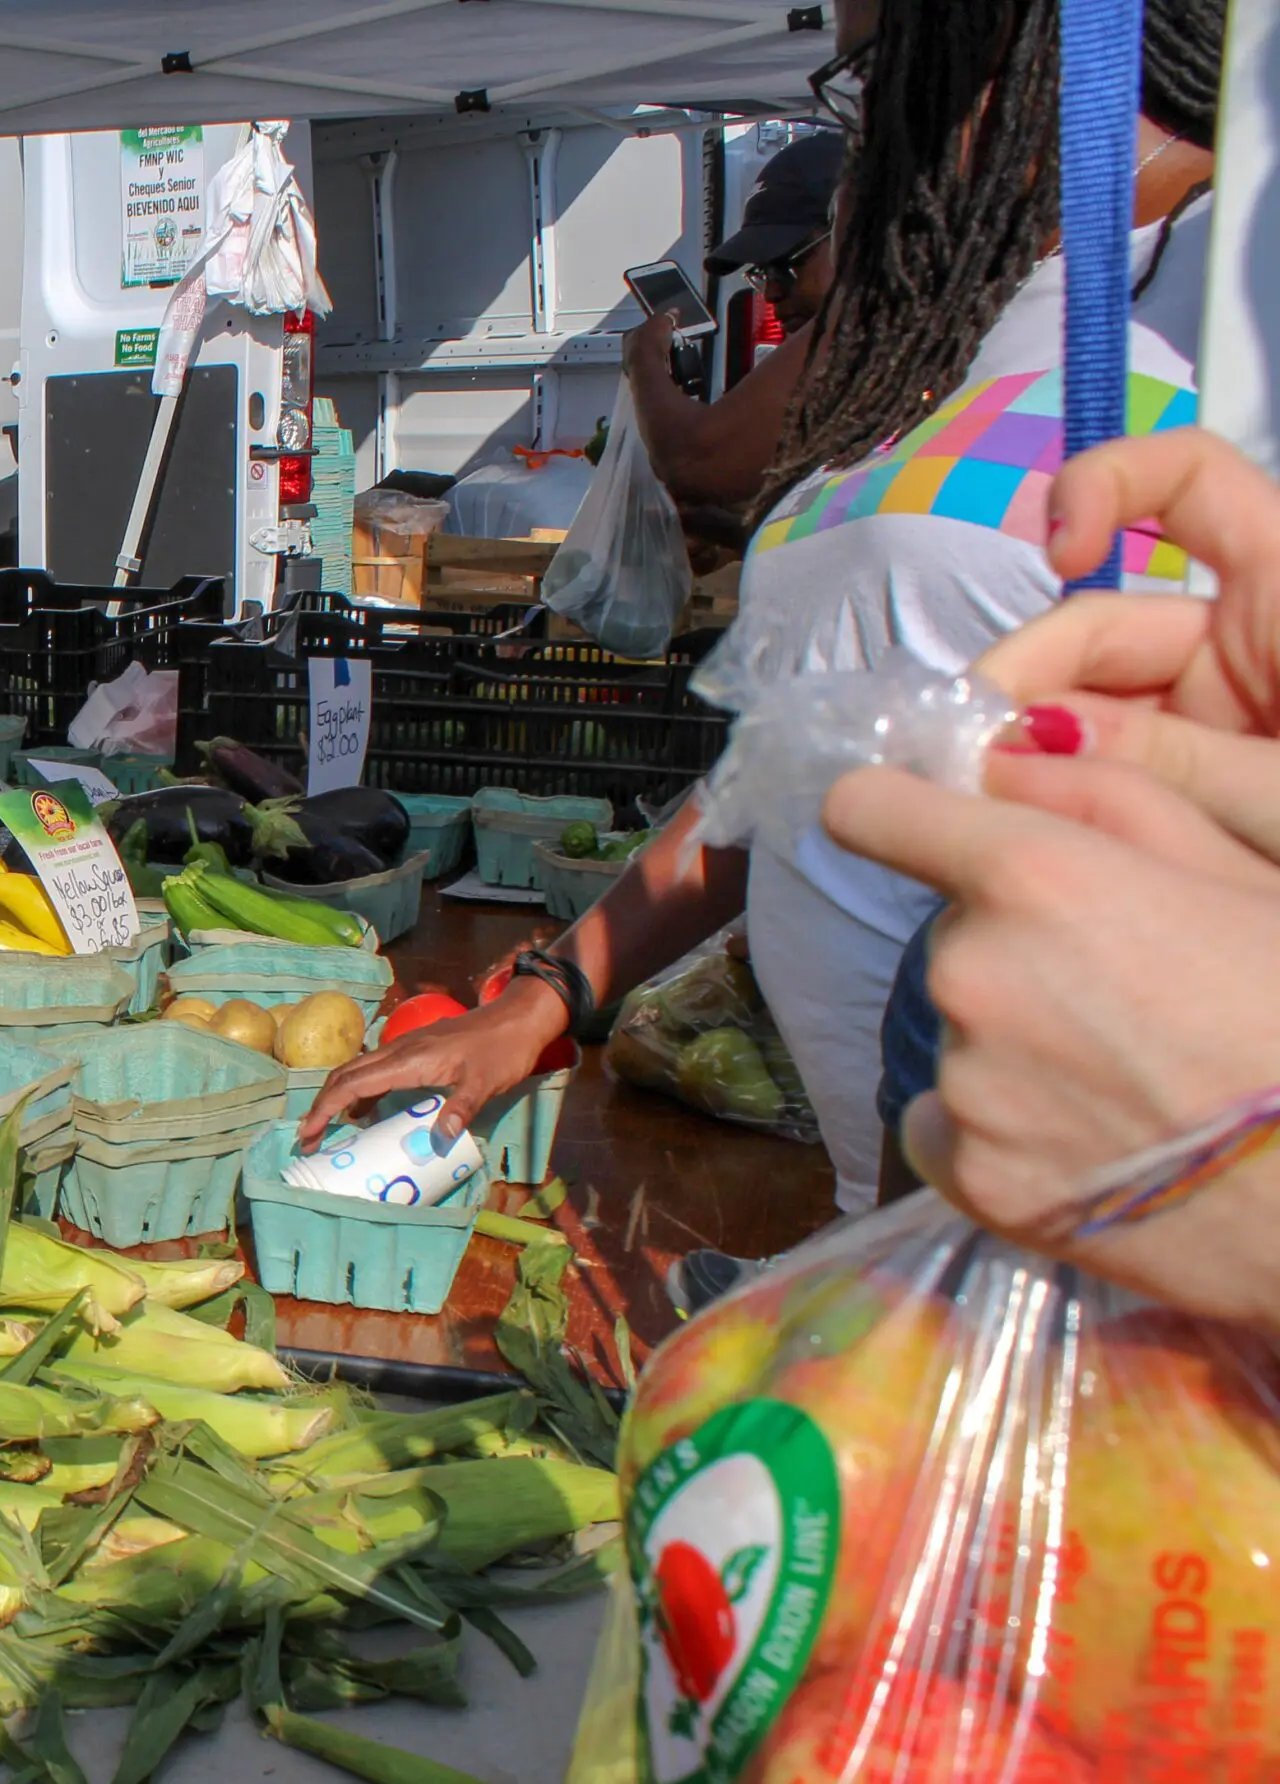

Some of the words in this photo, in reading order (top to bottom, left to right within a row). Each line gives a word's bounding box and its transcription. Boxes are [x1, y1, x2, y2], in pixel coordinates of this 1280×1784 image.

[139, 151, 164, 168] FMNP
[165, 149, 184, 164] WIC
[158, 167, 164, 180] y
[128, 181, 166, 198] Cheques
[167, 176, 196, 193] Senior
[126, 197, 175, 218] BIEVENIDO
[176, 195, 200, 212] AQUI
[120, 333, 131, 342] No
[132, 332, 155, 342] Farms
[121, 344, 132, 353] No
[134, 342, 153, 352] Food
[316, 700, 365, 740] Eggplant
[52, 868, 98, 909] Yellow
